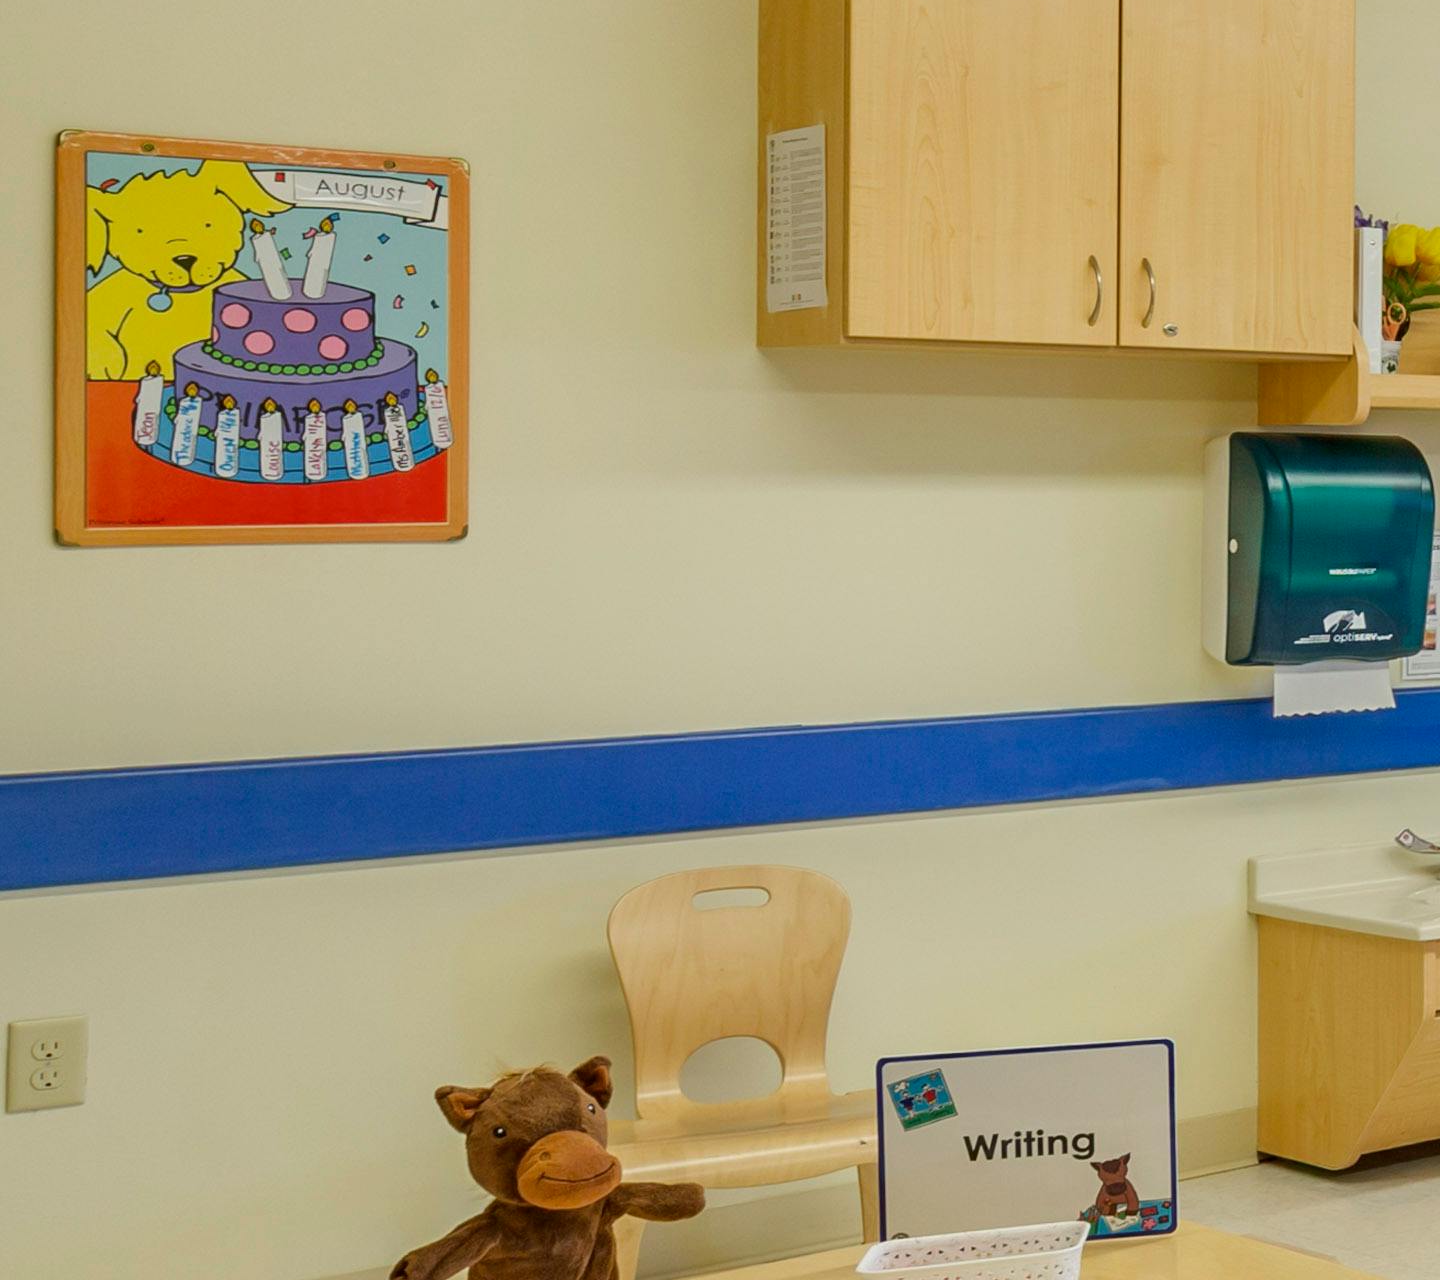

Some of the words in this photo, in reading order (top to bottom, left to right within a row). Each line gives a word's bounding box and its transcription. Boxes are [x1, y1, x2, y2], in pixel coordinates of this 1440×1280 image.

[315, 179, 405, 201] August
[137, 411, 156, 442] Jean
[175, 417, 193, 464] Theodore
[436, 416, 452, 443] Luna
[265, 440, 281, 477] Louise
[962, 1129, 1095, 1161] Writing
